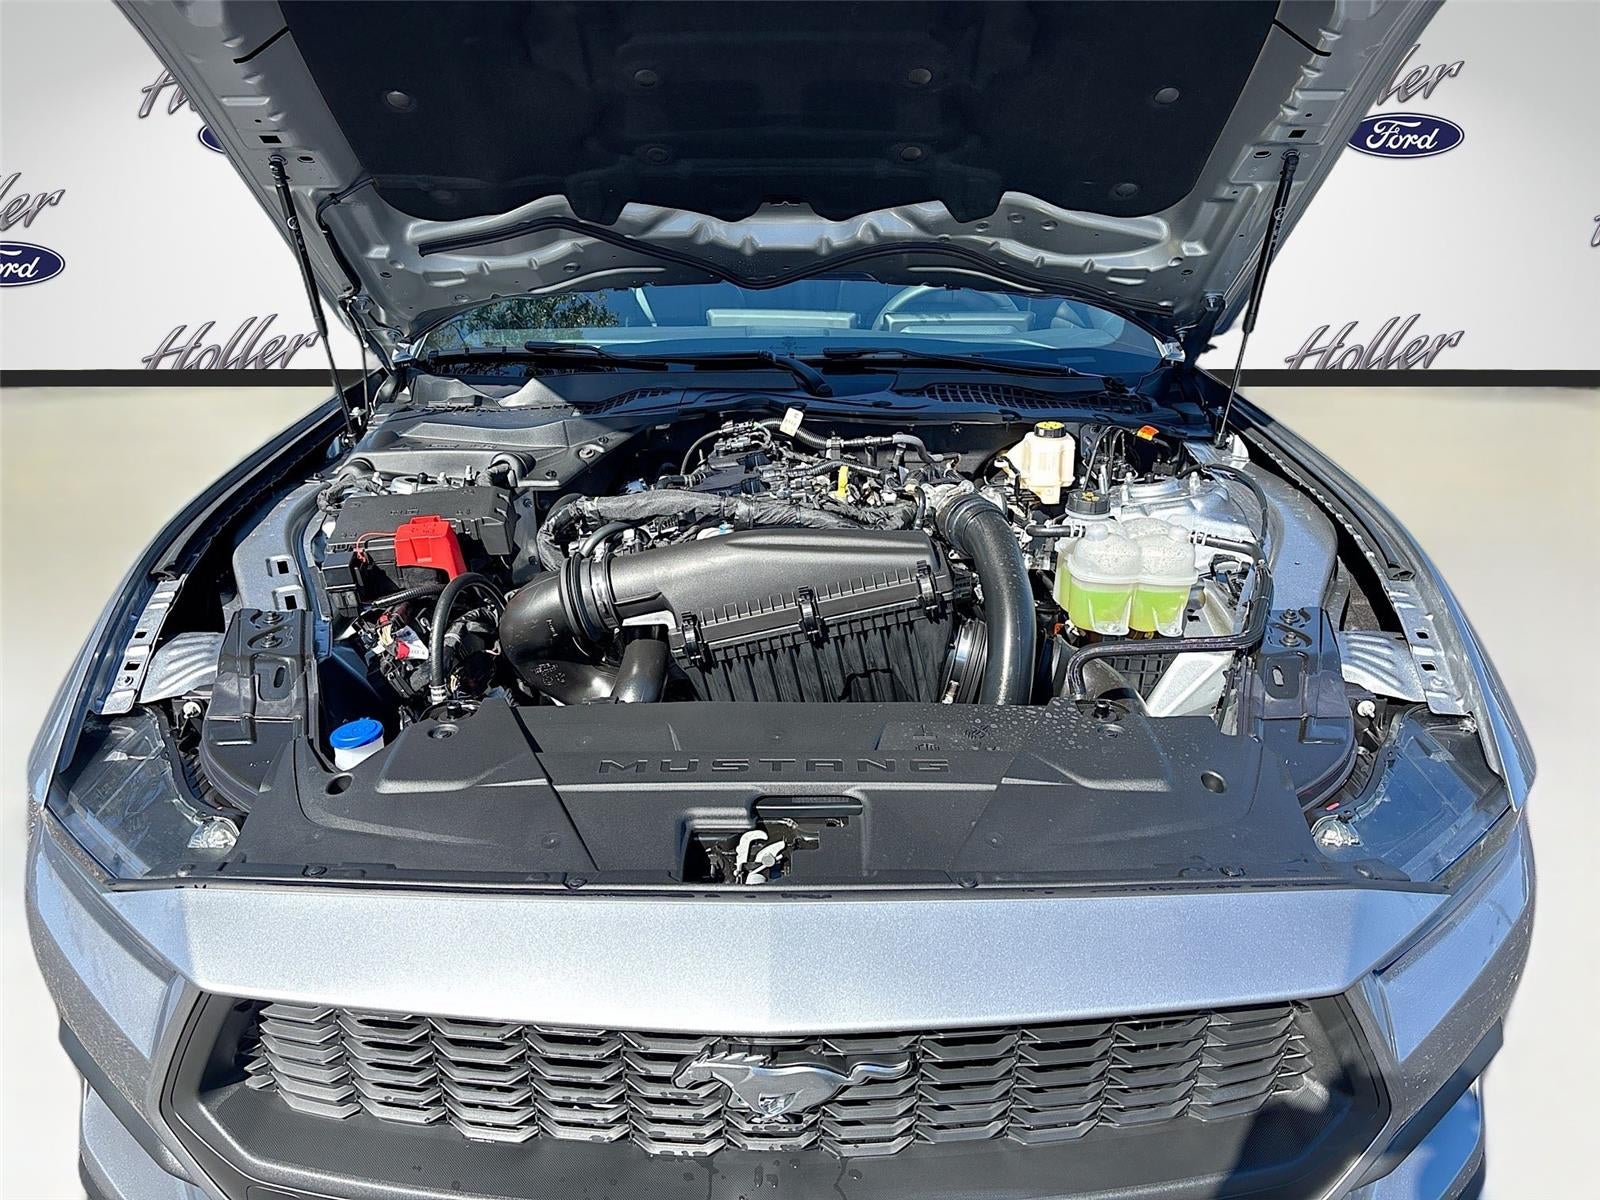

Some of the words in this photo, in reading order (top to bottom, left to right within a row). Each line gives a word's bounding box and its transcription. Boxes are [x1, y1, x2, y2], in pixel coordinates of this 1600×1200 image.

[1366, 120, 1440, 149] Ford
[142, 314, 320, 370] Holler
[1285, 314, 1465, 370] Holler
[599, 758, 951, 774] MUSTANG
